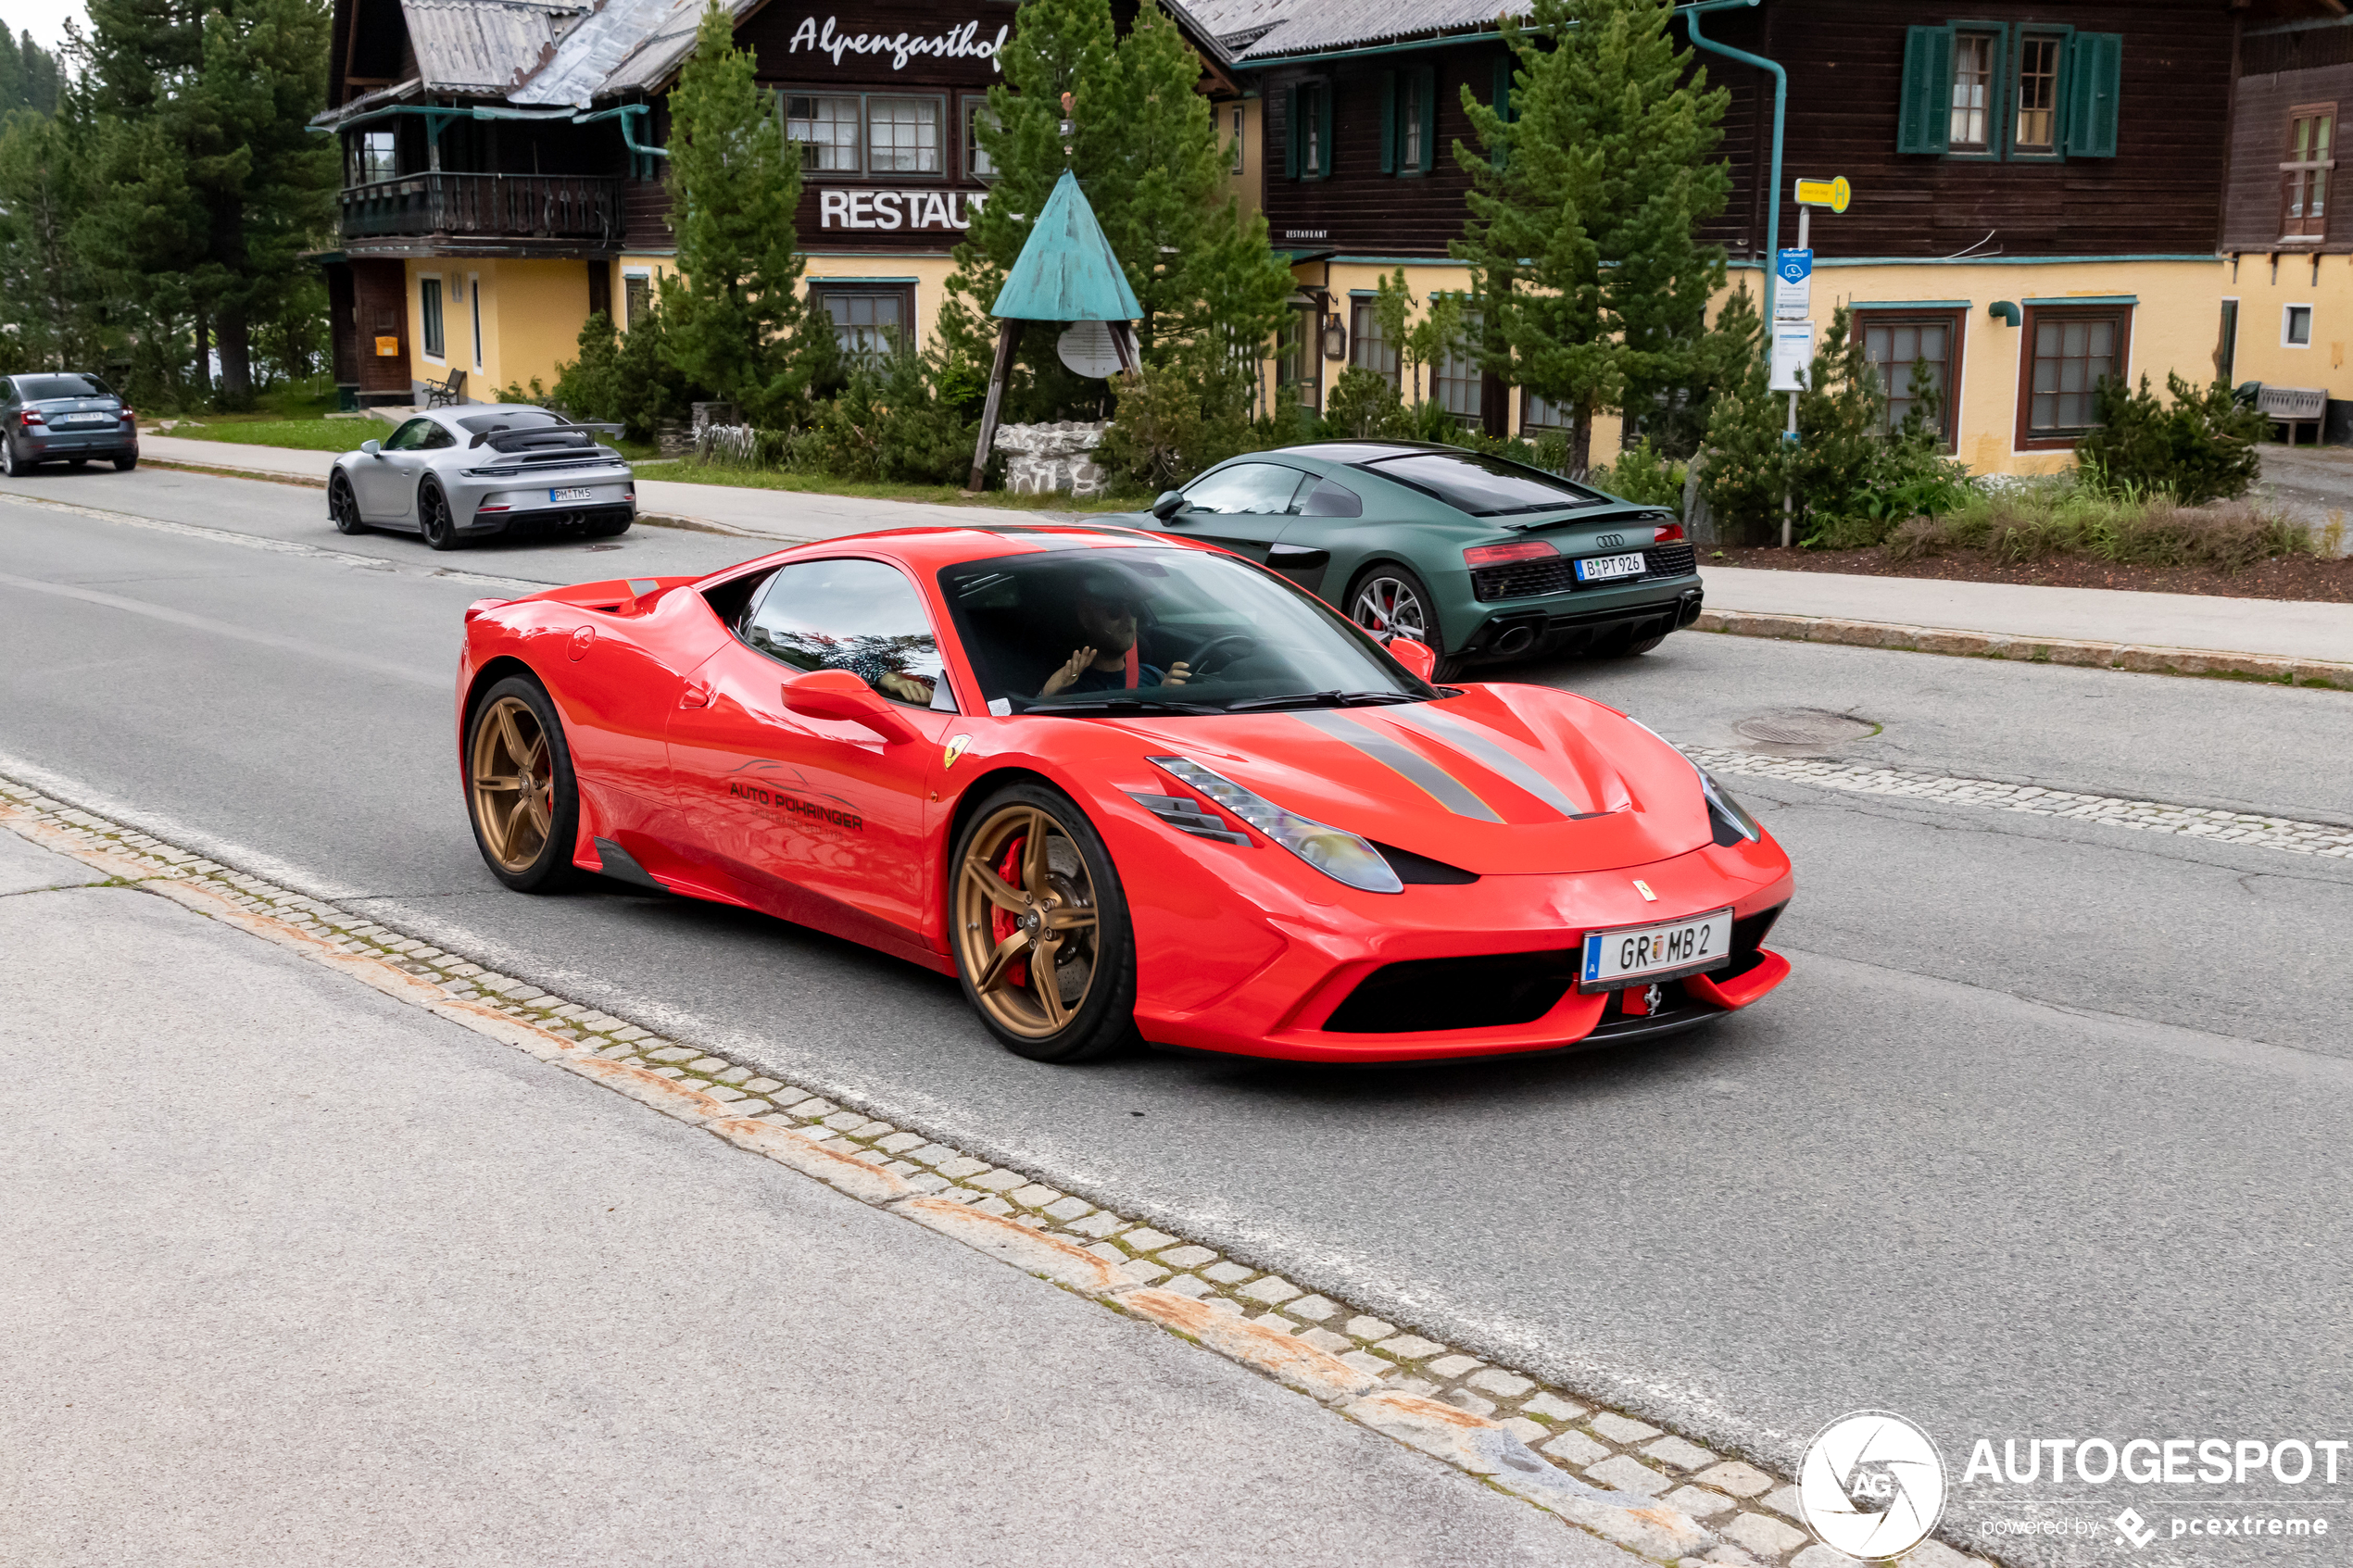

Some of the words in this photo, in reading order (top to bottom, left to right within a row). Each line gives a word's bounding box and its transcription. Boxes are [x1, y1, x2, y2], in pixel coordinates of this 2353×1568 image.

[789, 16, 1009, 73] Alpengasthof
[820, 190, 1026, 230] RESTAU
[1286, 230, 1327, 238] RESTAURANT
[555, 490, 568, 499] PM
[1586, 560, 1595, 576] B
[1601, 558, 1617, 574] PT
[1618, 555, 1640, 572] 926
[730, 783, 770, 806] AUTO
[775, 794, 863, 832] PÖHRINGER
[1621, 935, 1650, 970] GR
[1667, 927, 1694, 963] MB
[1698, 923, 1710, 956] 2
[1588, 963, 1596, 973] A
